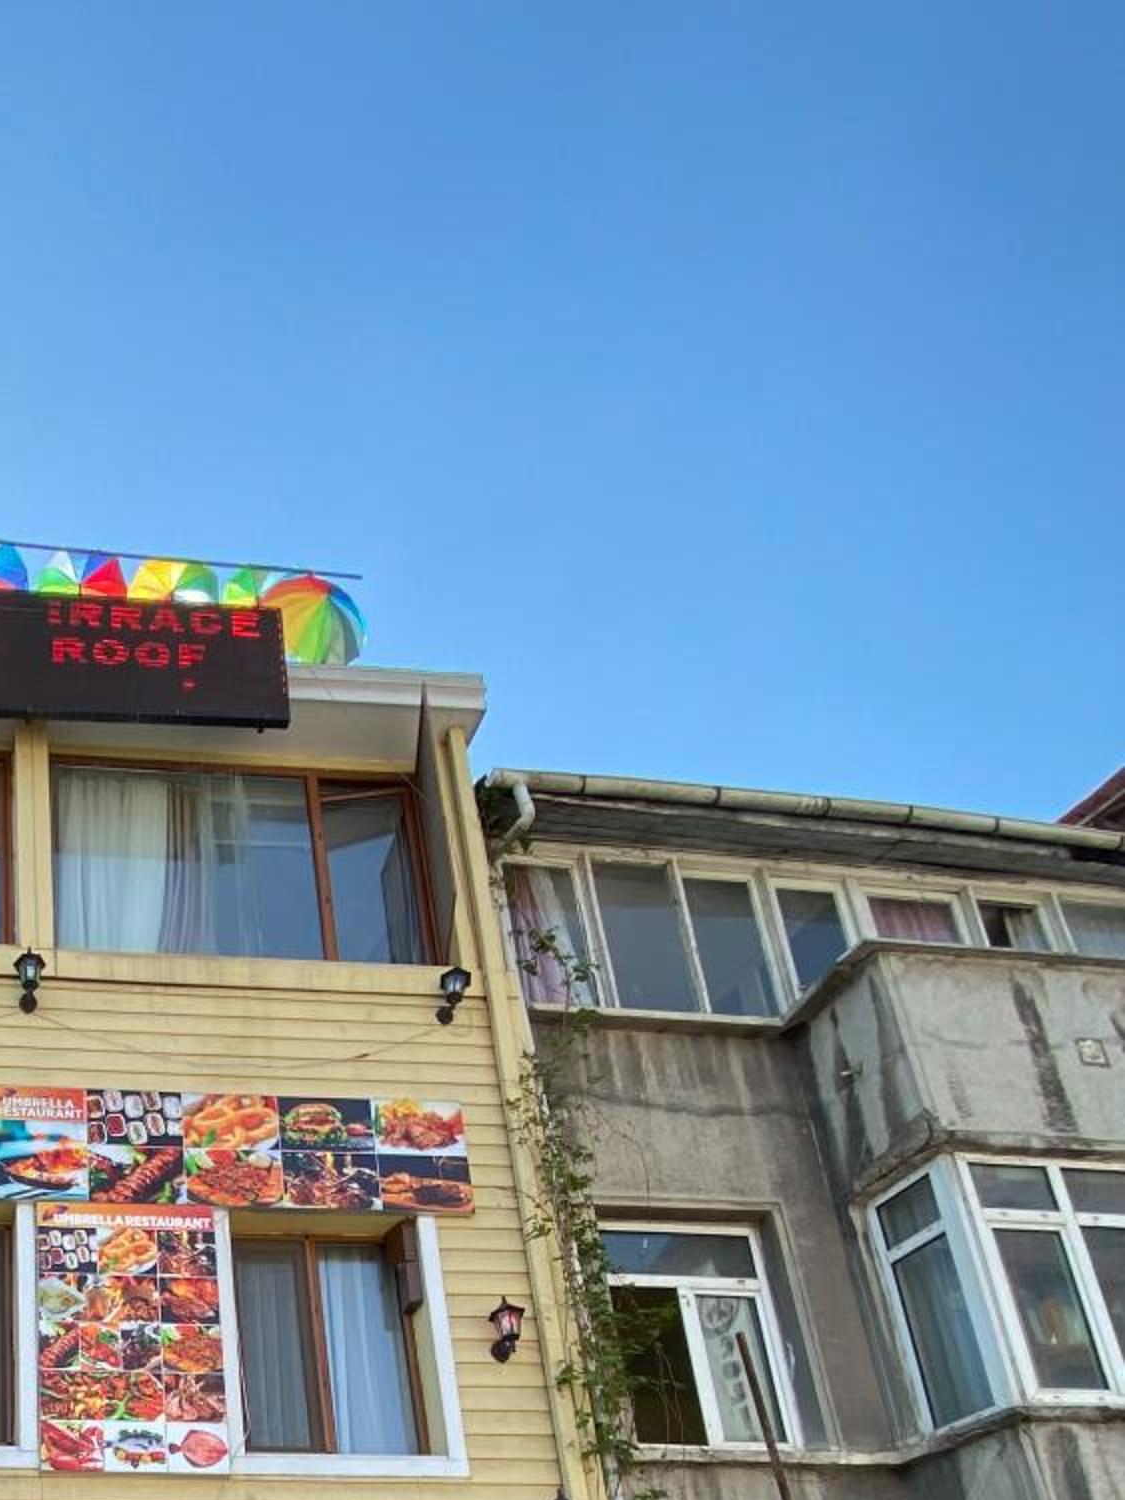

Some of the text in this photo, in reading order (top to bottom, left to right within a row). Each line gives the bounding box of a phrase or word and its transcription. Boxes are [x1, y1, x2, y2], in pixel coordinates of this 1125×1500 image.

[51, 638, 207, 668] ROOF
[2, 1096, 74, 1109] UMBRELLA
[54, 1212, 211, 1229] UMBRELLA RESTAURANT
